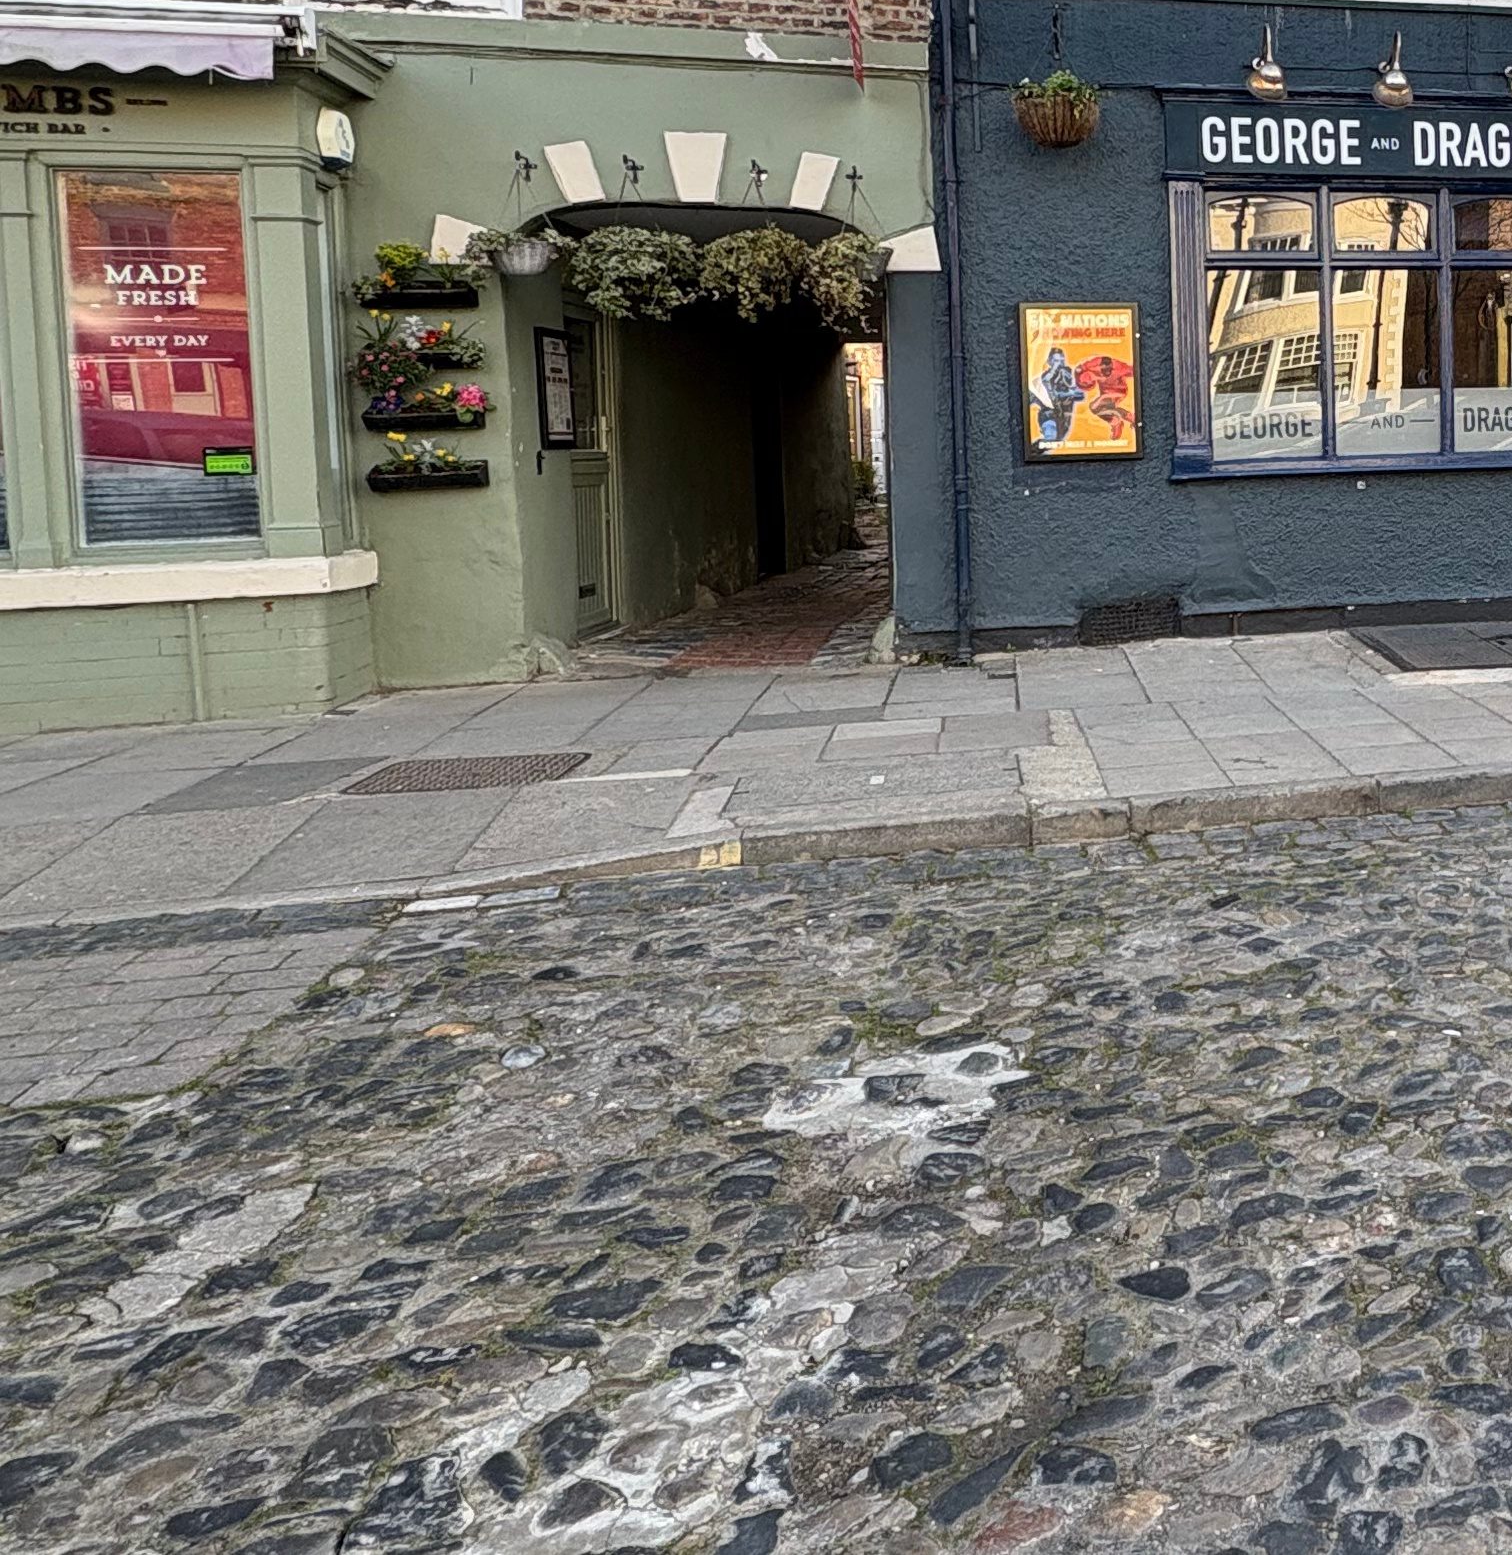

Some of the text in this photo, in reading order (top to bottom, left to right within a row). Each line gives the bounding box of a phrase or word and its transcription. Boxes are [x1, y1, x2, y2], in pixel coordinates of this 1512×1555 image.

[47, 123, 86, 134] BAR
[1201, 116, 1362, 165] GEORGE
[1370, 137, 1400, 151] AND
[103, 264, 208, 285] MADE
[116, 290, 199, 306] FRESH
[1060, 313, 1129, 327] NATIONS
[1096, 328, 1126, 338] HERE
[110, 335, 209, 347] EVERY DAY
[1223, 412, 1313, 440] GEORGE
[1370, 414, 1405, 430] AND
